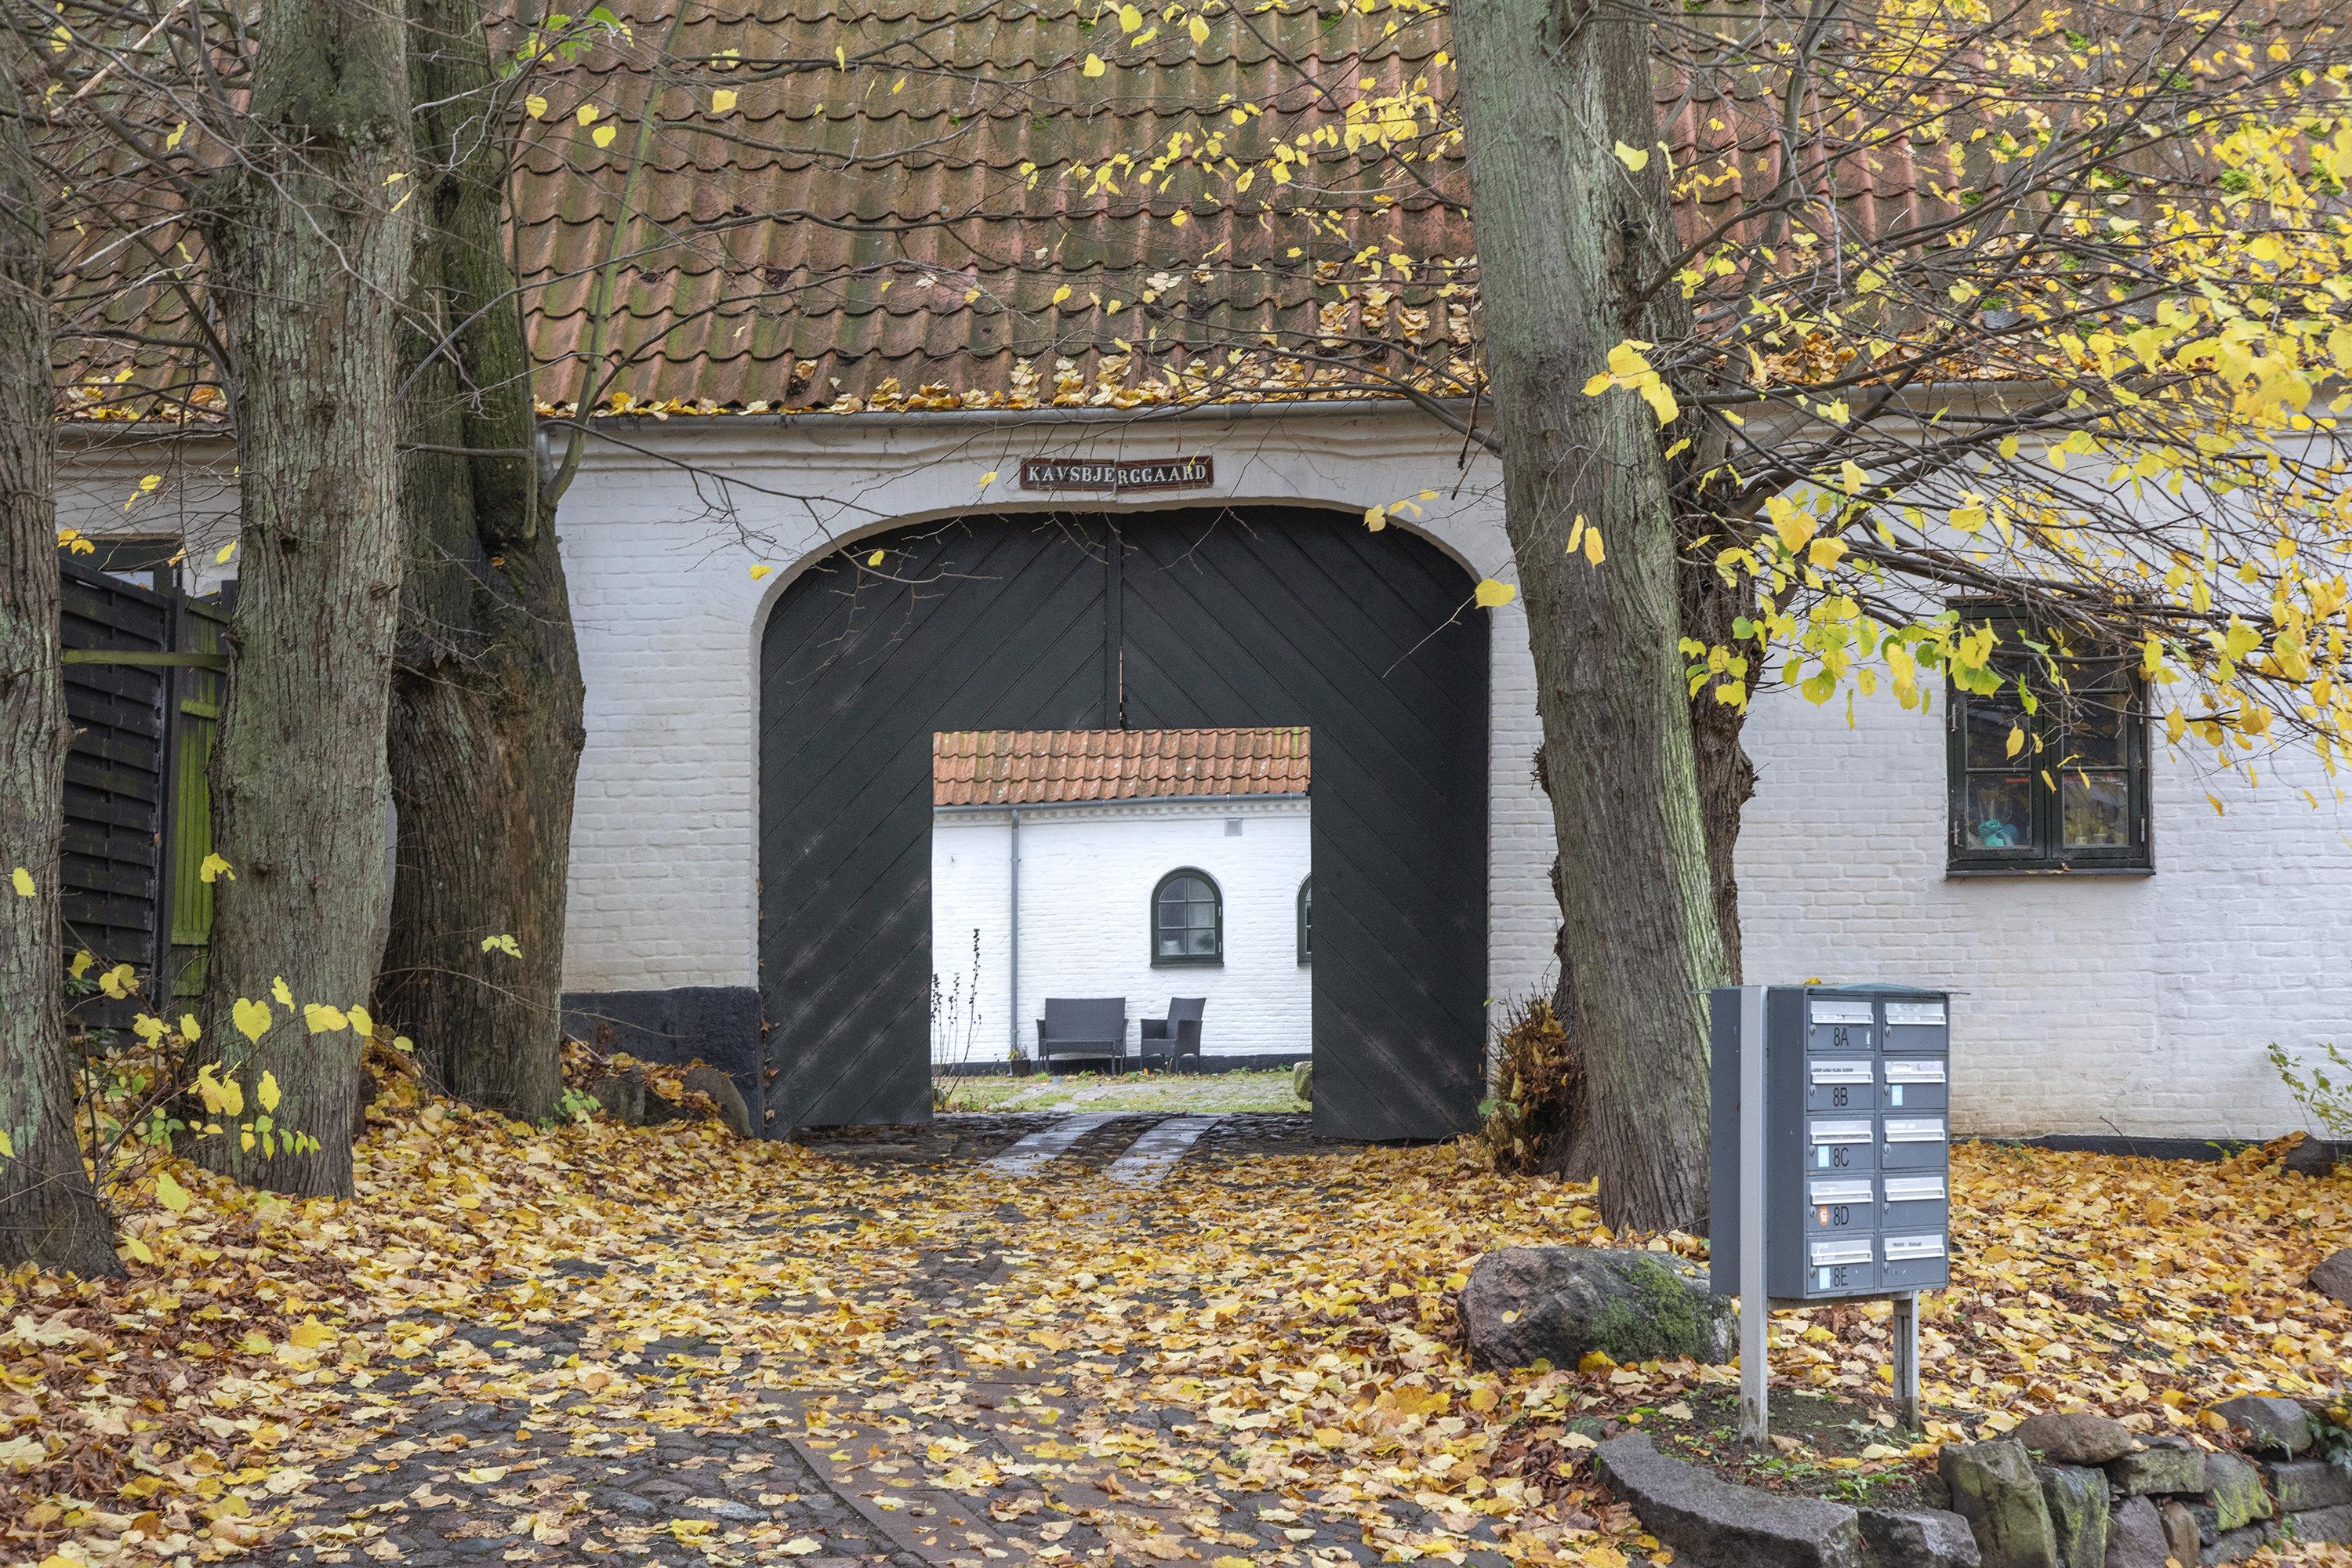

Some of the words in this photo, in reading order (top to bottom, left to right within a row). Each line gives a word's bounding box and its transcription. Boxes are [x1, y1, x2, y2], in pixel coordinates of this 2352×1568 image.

[1028, 464, 1207, 484] KAVSBJERGGAARD
[1833, 1026, 1849, 1047] 8A
[1833, 1087, 1849, 1107] 8B
[1833, 1147, 1849, 1167] 8C
[1833, 1206, 1849, 1226] 8D
[1833, 1266, 1849, 1287] 8E
